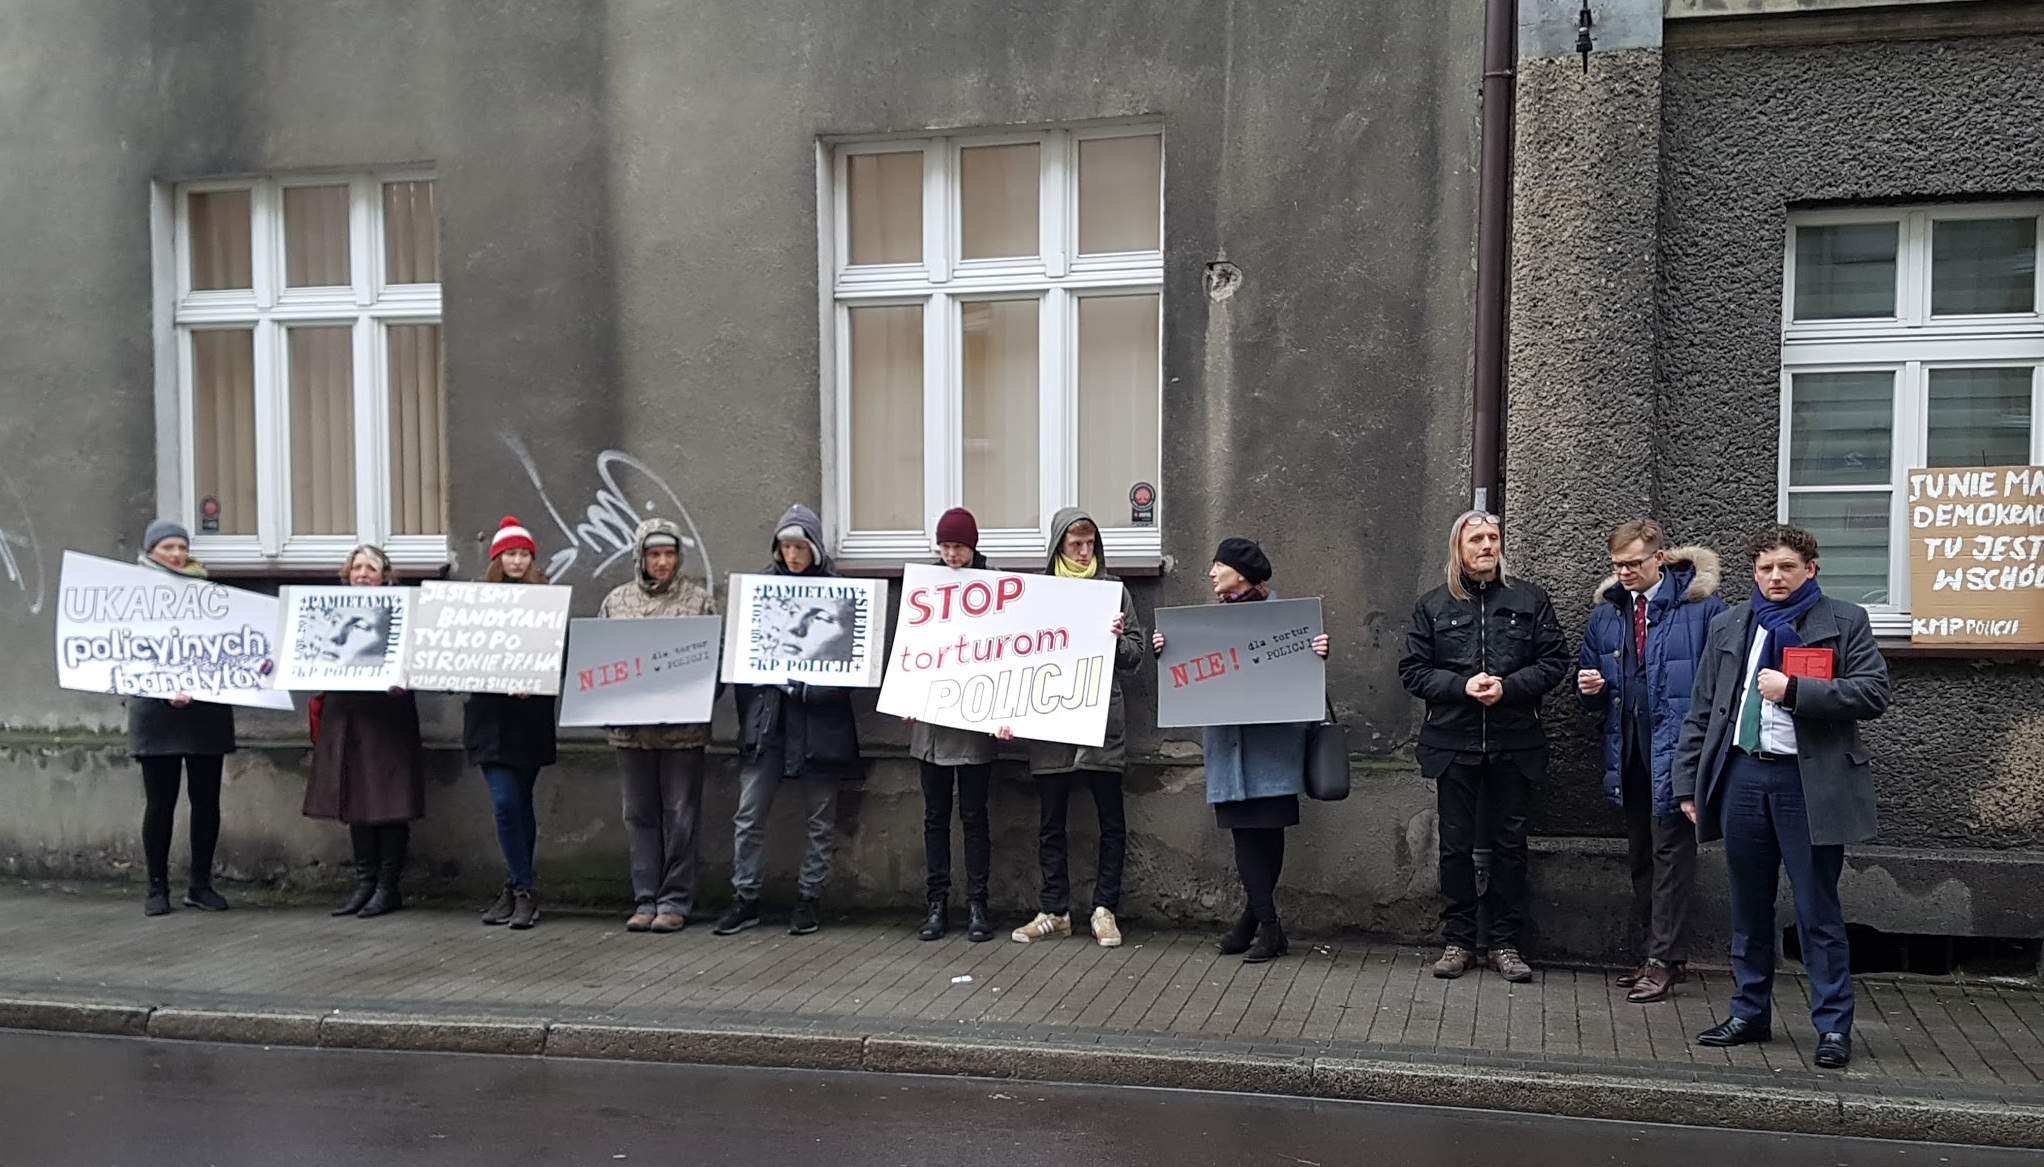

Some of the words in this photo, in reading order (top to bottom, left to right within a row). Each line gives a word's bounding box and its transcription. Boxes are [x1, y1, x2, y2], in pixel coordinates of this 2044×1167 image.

[1948, 472, 1998, 498] NIE
[1924, 536, 1963, 561] TU
[1972, 534, 2044, 561] JEST
[907, 575, 1025, 627] STOP
[436, 606, 565, 629] BANDYTAMI
[1912, 617, 1964, 636] KMP
[64, 624, 268, 669] policyjnych
[414, 628, 486, 648] TYLKO
[489, 630, 521, 650] PO
[900, 626, 1069, 672] torturom
[1248, 639, 1266, 651] dla
[1272, 626, 1309, 643] tortur
[1266, 638, 1313, 661] POLICJI
[413, 651, 501, 671] STRONIE
[577, 656, 643, 692] NIE!
[787, 660, 850, 673] POLICJI
[1170, 647, 1241, 689] NIE!
[923, 655, 1104, 723] POLICJI
